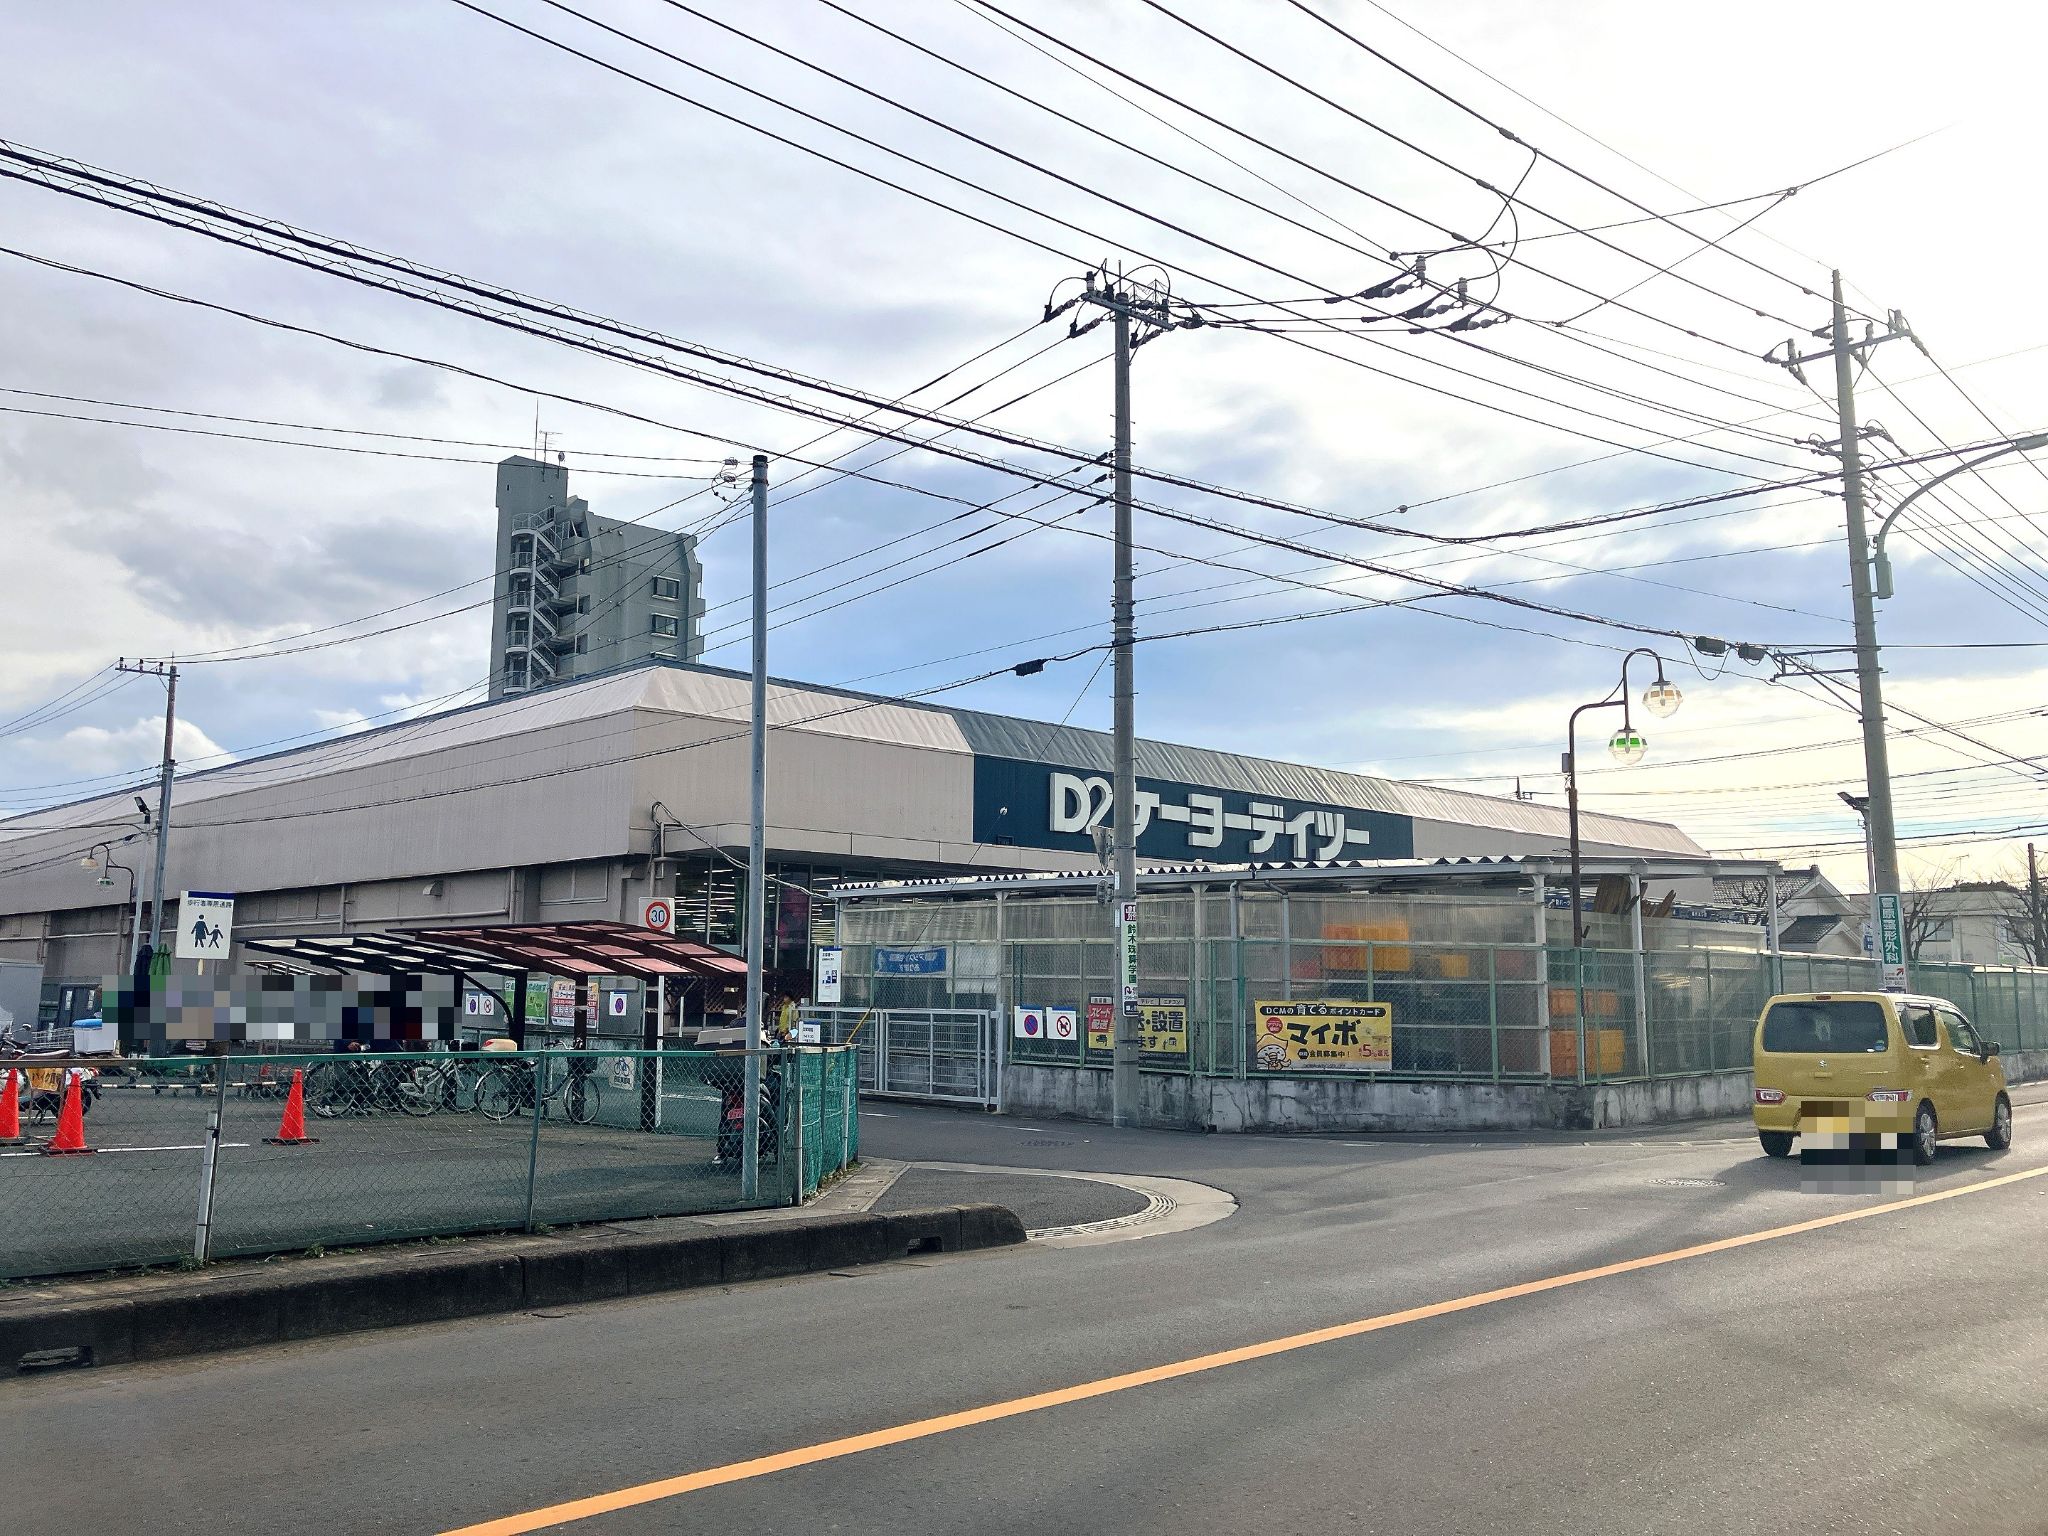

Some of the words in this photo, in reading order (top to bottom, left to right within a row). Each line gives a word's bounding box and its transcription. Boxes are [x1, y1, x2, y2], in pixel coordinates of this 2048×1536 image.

[651, 909, 666, 923] 30
[1090, 1007, 1112, 1018] スピード
[1287, 1019, 1362, 1046] マイボ
